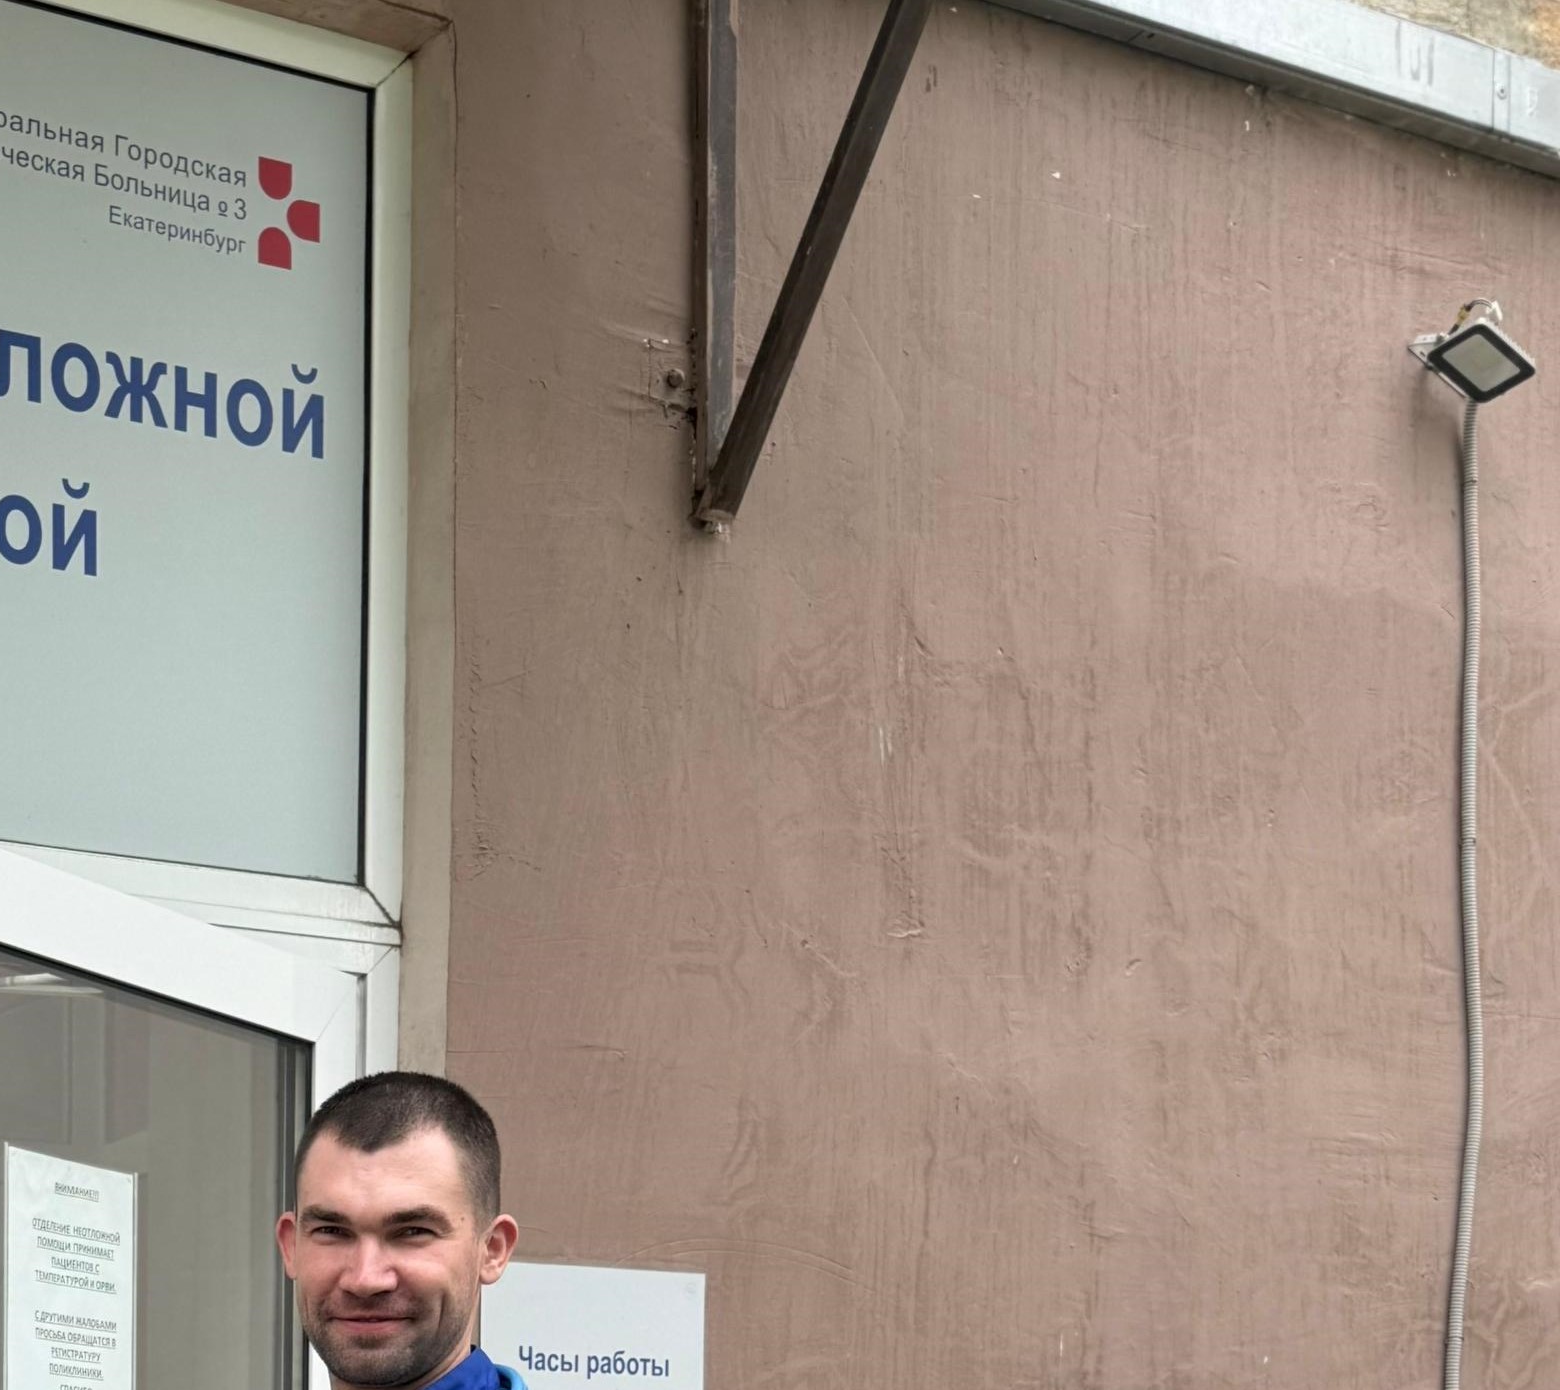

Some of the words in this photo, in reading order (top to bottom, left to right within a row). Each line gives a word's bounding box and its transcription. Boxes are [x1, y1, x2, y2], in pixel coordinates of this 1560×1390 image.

[114, 135, 247, 188] Городская
[94, 164, 210, 213] Больница
[233, 198, 247, 220] 3
[108, 205, 247, 255] Екатеринбург
[32, 1217, 71, 1234] ОТДЕЛЕНИЕ
[73, 1226, 121, 1244] НЕОТЛОЖНОЙ
[37, 1236, 71, 1251] ПОМОЩИ
[73, 1242, 115, 1259] ПРИНИМАЕТ
[51, 1257, 94, 1272] ПАЦИЕНТОВ
[35, 1269, 89, 1288] ТЕМПЕРАТУРОЙ
[40, 1311, 74, 1324] ДРУГИМИ
[75, 1317, 117, 1331] ЖАЛОБАМИ
[35, 1327, 66, 1340] ПРОСЬБА
[51, 1347, 101, 1362] РЕГИСТРАТУРУ
[518, 1345, 579, 1373] Часы
[587, 1350, 670, 1379] работы
